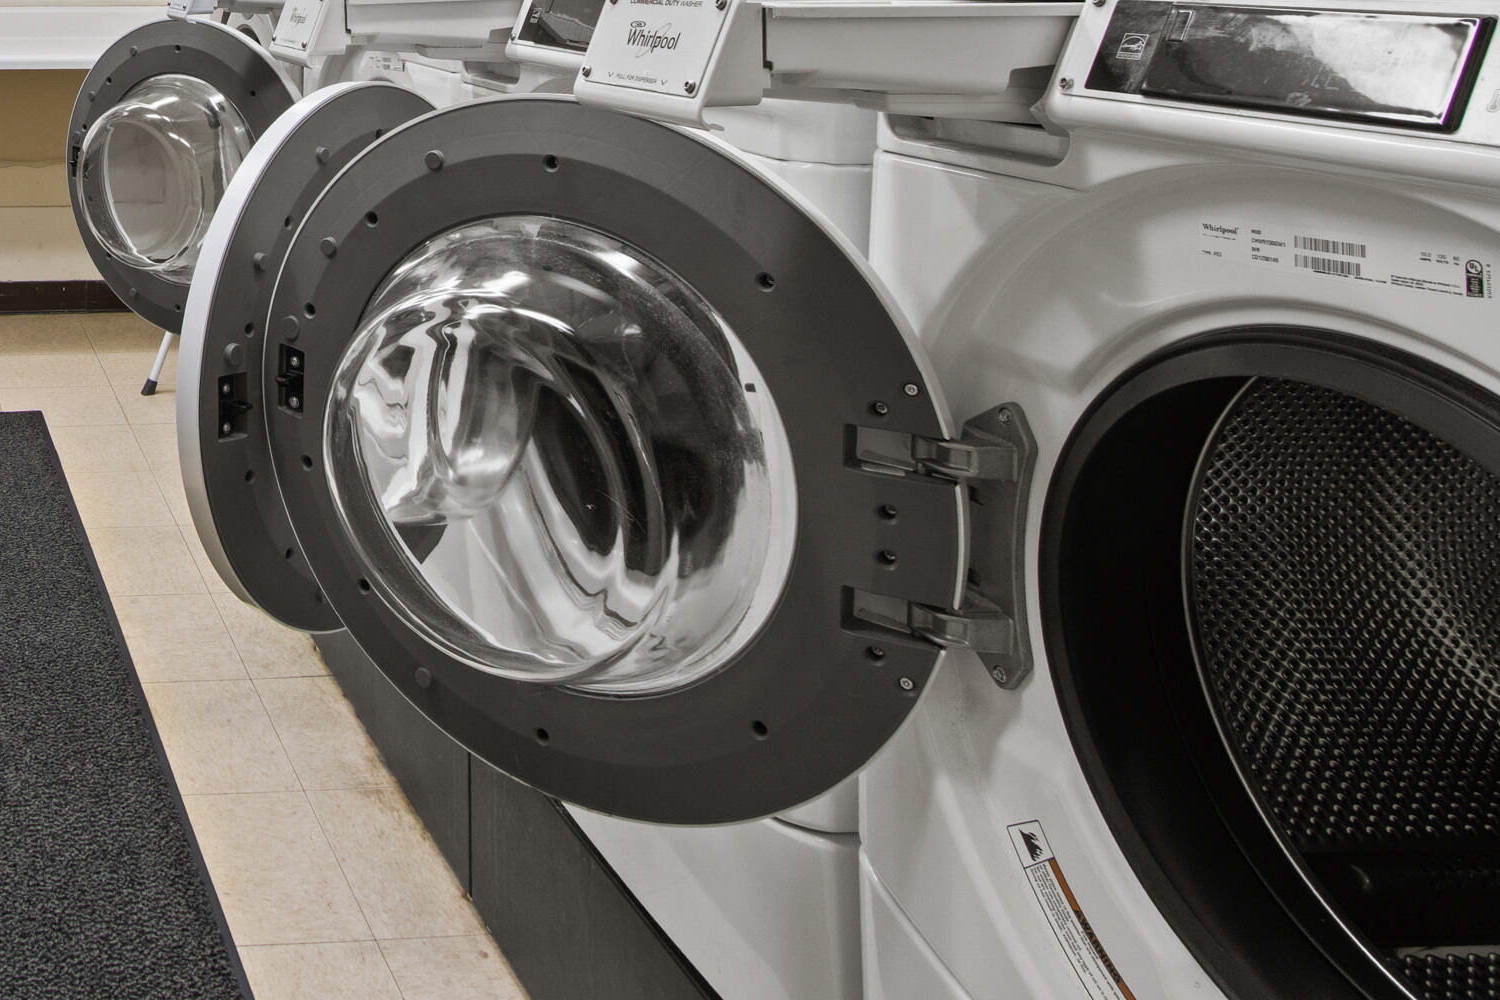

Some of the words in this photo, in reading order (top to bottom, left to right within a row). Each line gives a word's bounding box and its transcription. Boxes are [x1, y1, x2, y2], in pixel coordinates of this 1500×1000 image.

[665, 0, 680, 7] DUTY
[626, 28, 681, 54] Whirlpool
[1202, 223, 1238, 235] Whirlpool
